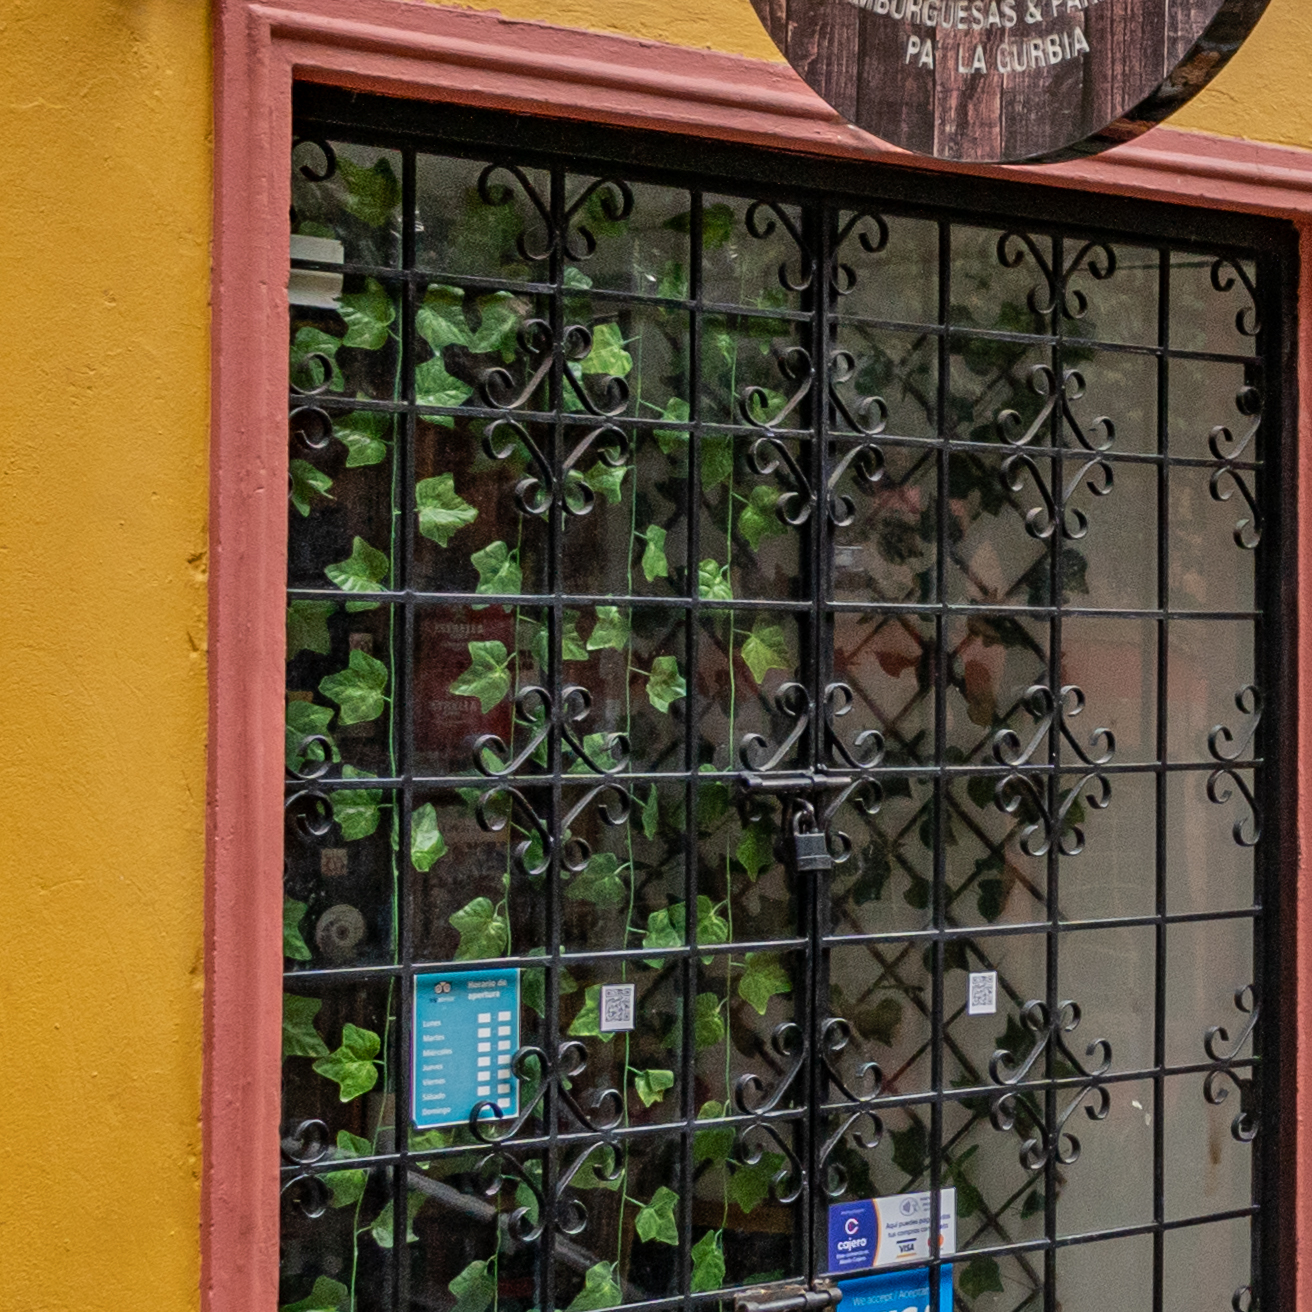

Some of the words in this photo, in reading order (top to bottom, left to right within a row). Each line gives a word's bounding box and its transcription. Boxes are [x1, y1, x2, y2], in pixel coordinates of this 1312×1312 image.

[958, 43, 987, 74] LA
[997, 26, 1090, 74] GURBIA
[837, 1237, 868, 1251] cajero
[898, 1243, 915, 1254] VISA
